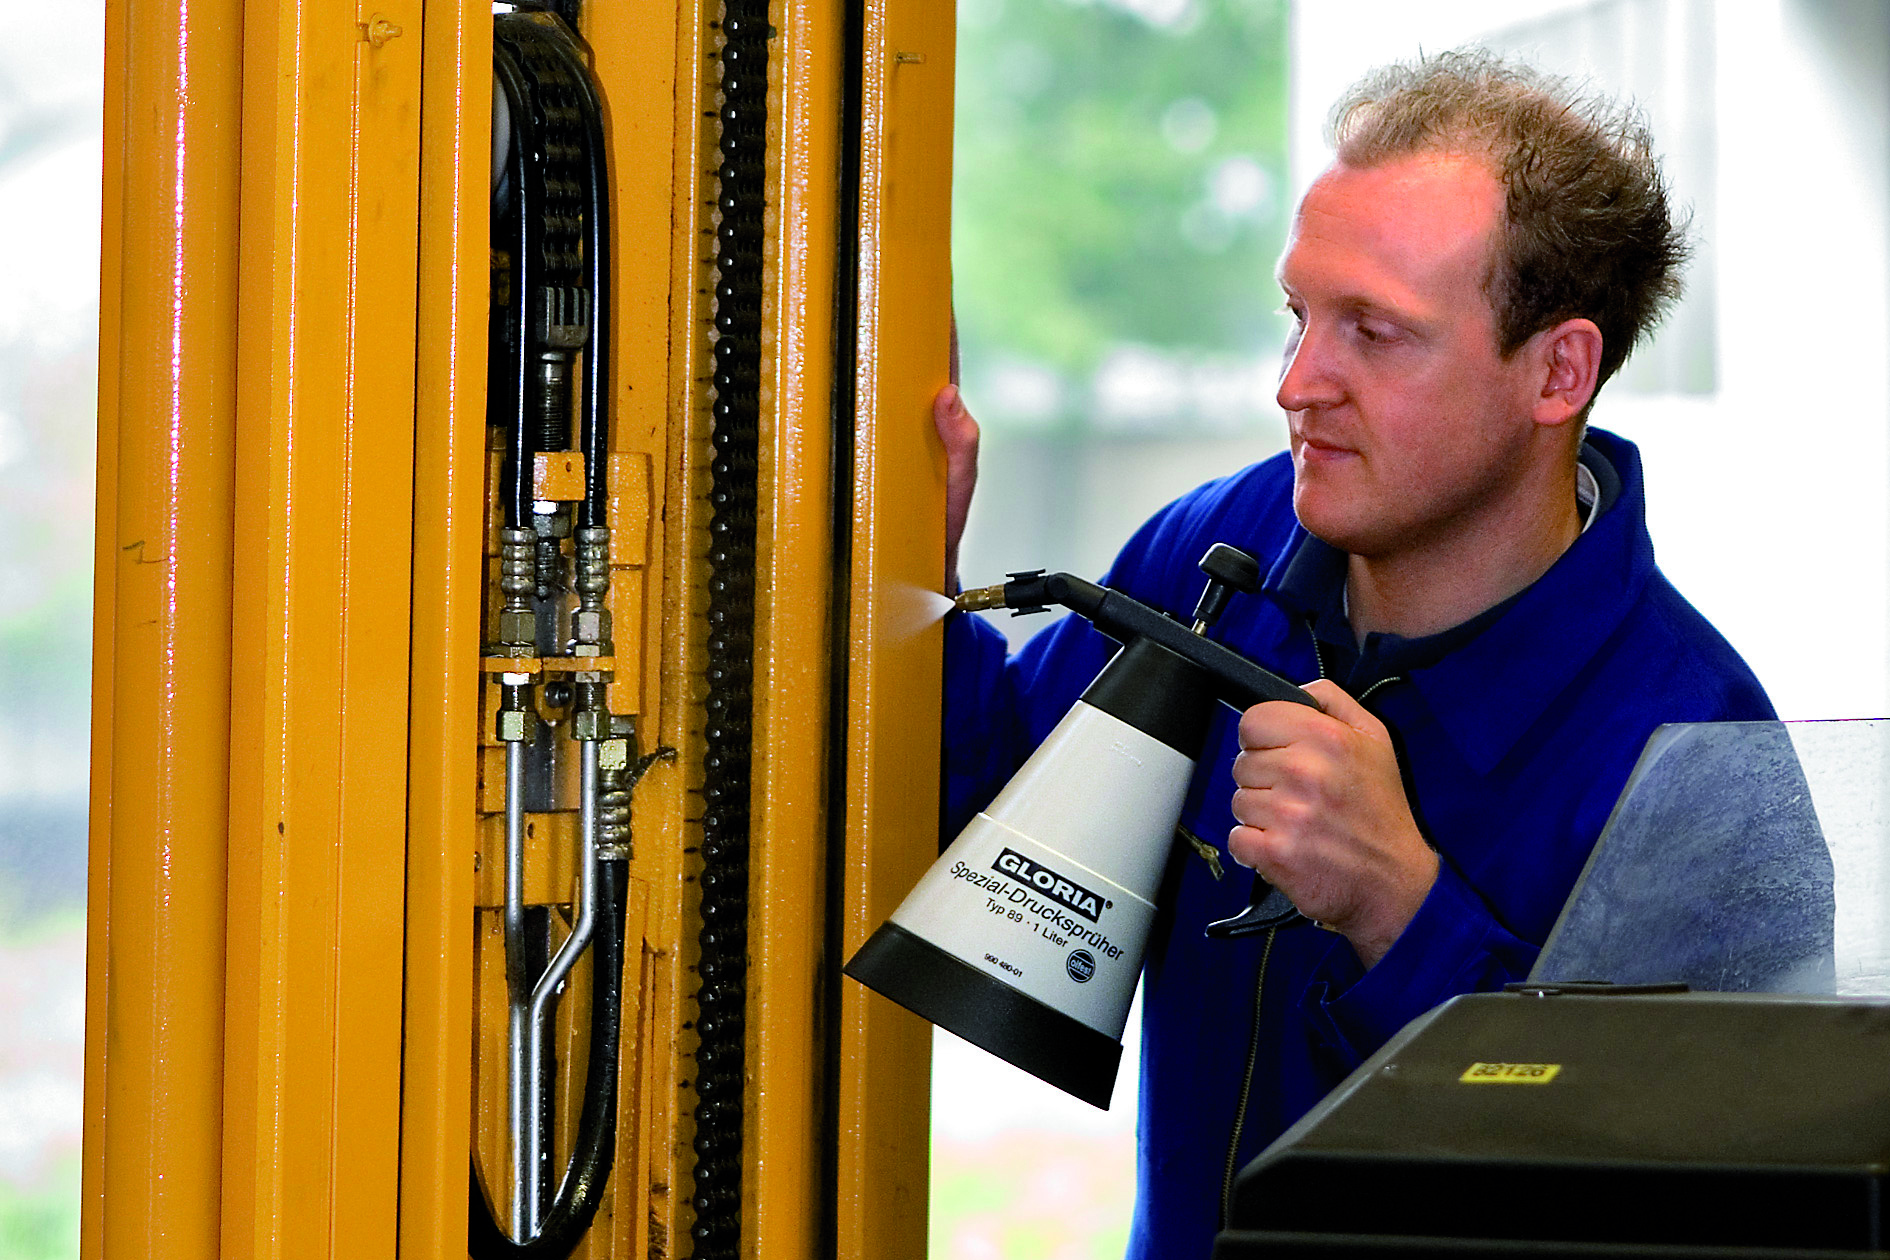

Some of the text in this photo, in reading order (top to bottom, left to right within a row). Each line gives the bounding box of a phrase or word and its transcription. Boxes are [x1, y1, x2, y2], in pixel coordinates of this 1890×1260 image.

[950, 861, 1125, 960] Spezial-Drucksprüher
[999, 854, 1097, 917] GLORIA
[986, 897, 1068, 947] Typ 89 1 Liter
